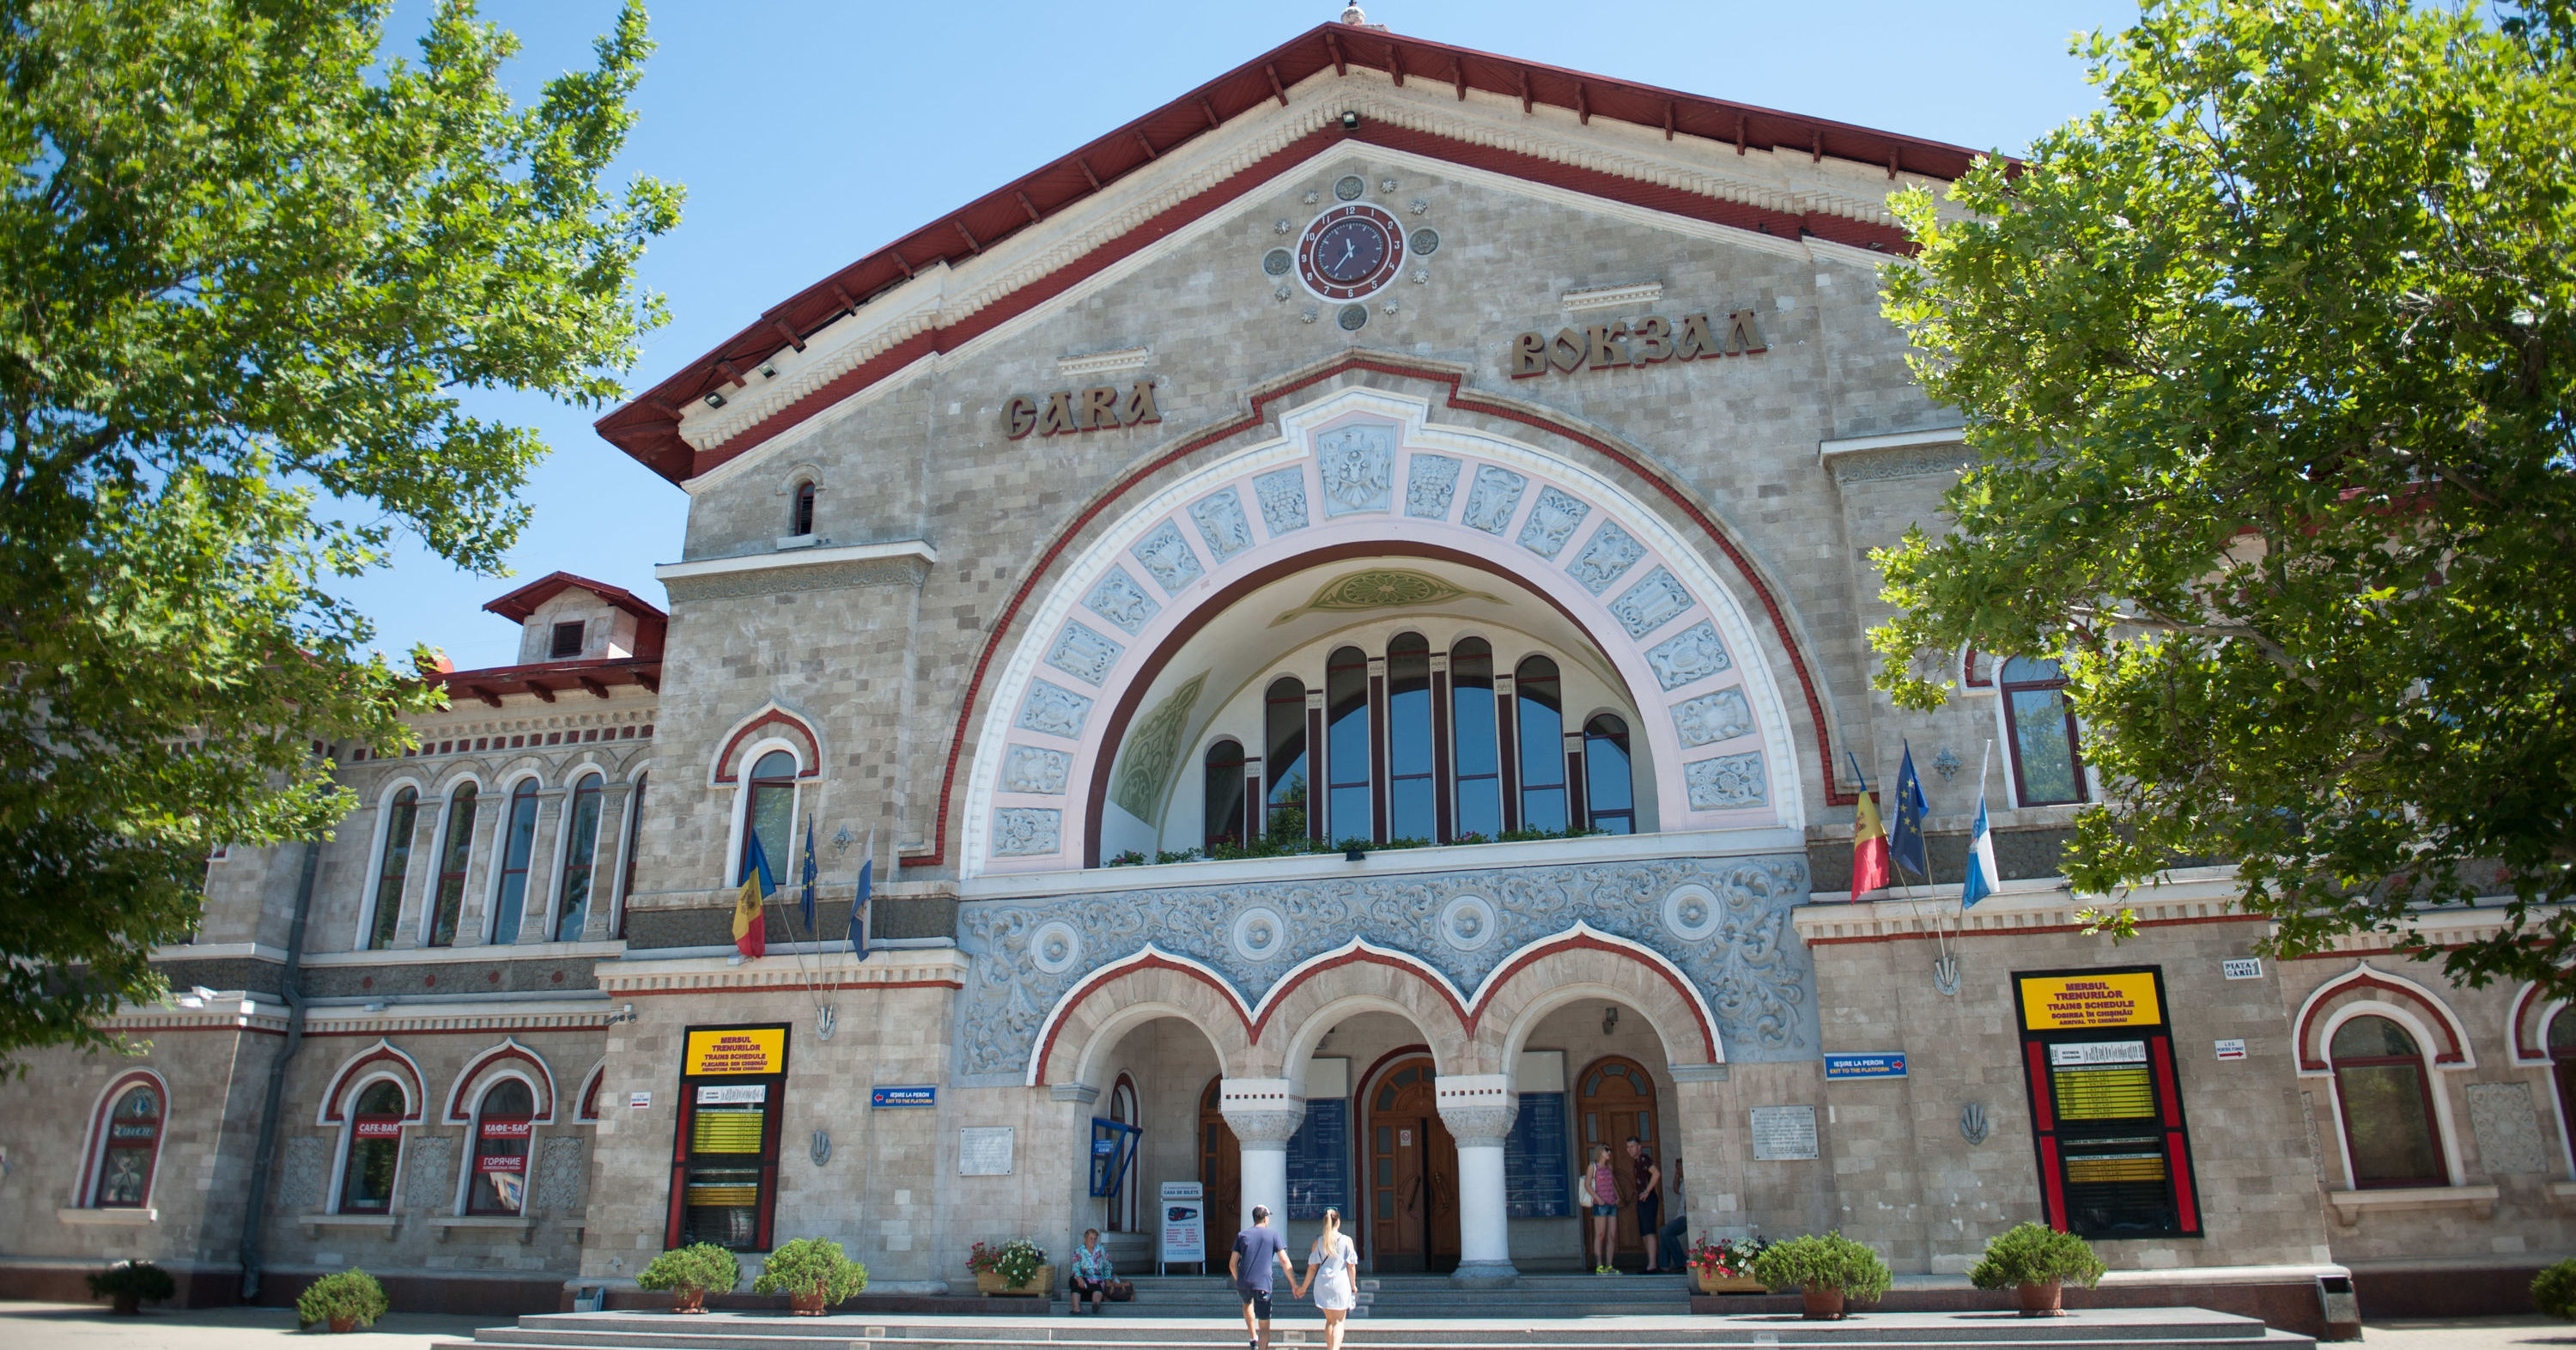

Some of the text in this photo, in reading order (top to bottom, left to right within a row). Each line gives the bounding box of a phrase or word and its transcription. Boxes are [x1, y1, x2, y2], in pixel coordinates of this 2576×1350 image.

[1370, 208, 1374, 216] 1
[1322, 216, 1329, 224] 11
[1388, 221, 1394, 229] 2
[1305, 233, 1315, 241] 10
[1394, 240, 1400, 249] 3
[1307, 272, 1312, 281] 8
[1372, 281, 1377, 289] 5
[1324, 286, 1329, 295] 7
[1347, 289, 1353, 297] 6
[1511, 308, 1767, 380] ВОКЗАЛ
[1000, 380, 1162, 441] GARA
[2065, 982, 2109, 991] MERSUL
[2054, 990, 2123, 1000] TRENURILOR
[2047, 1000, 2135, 1011] TRAINS SCHEDULE
[359, 1123, 398, 1132] CAFE-BAR
[485, 1123, 528, 1132] КАФЕ-БАР
[483, 1157, 521, 1165] ГОРЯЧИЕ
